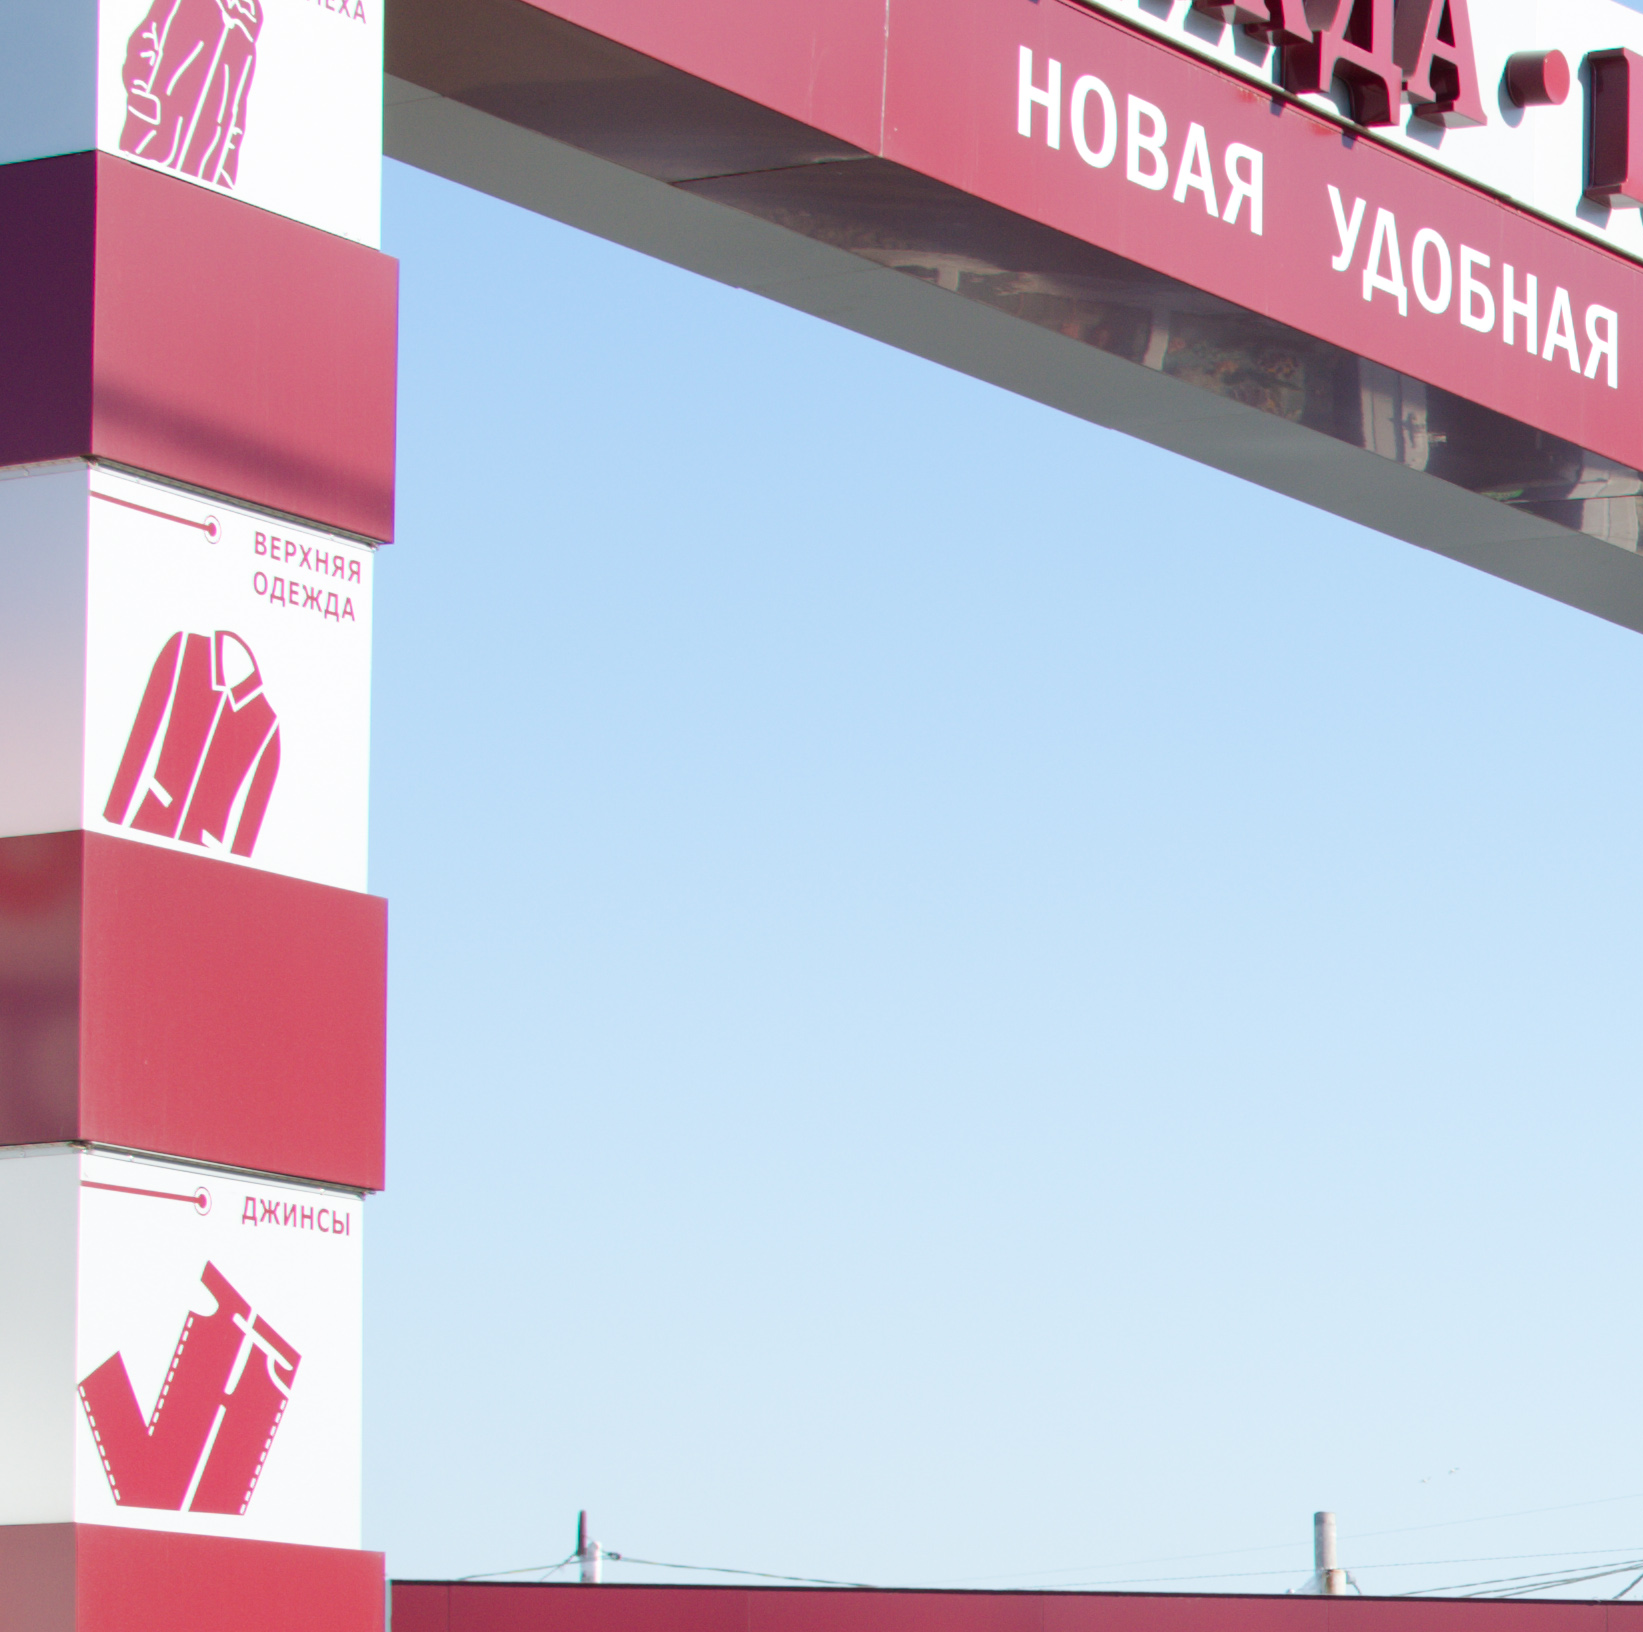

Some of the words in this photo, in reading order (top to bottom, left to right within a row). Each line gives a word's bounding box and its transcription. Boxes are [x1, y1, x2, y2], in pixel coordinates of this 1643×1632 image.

[1017, 45, 1264, 235] НОВАЯ
[1326, 184, 1618, 389] УДОБНАЯ
[255, 531, 361, 584] ВЕРХНЯЯ
[253, 572, 355, 622] ОДЕЖДА
[242, 1196, 350, 1236] ДЖИНСЫ
